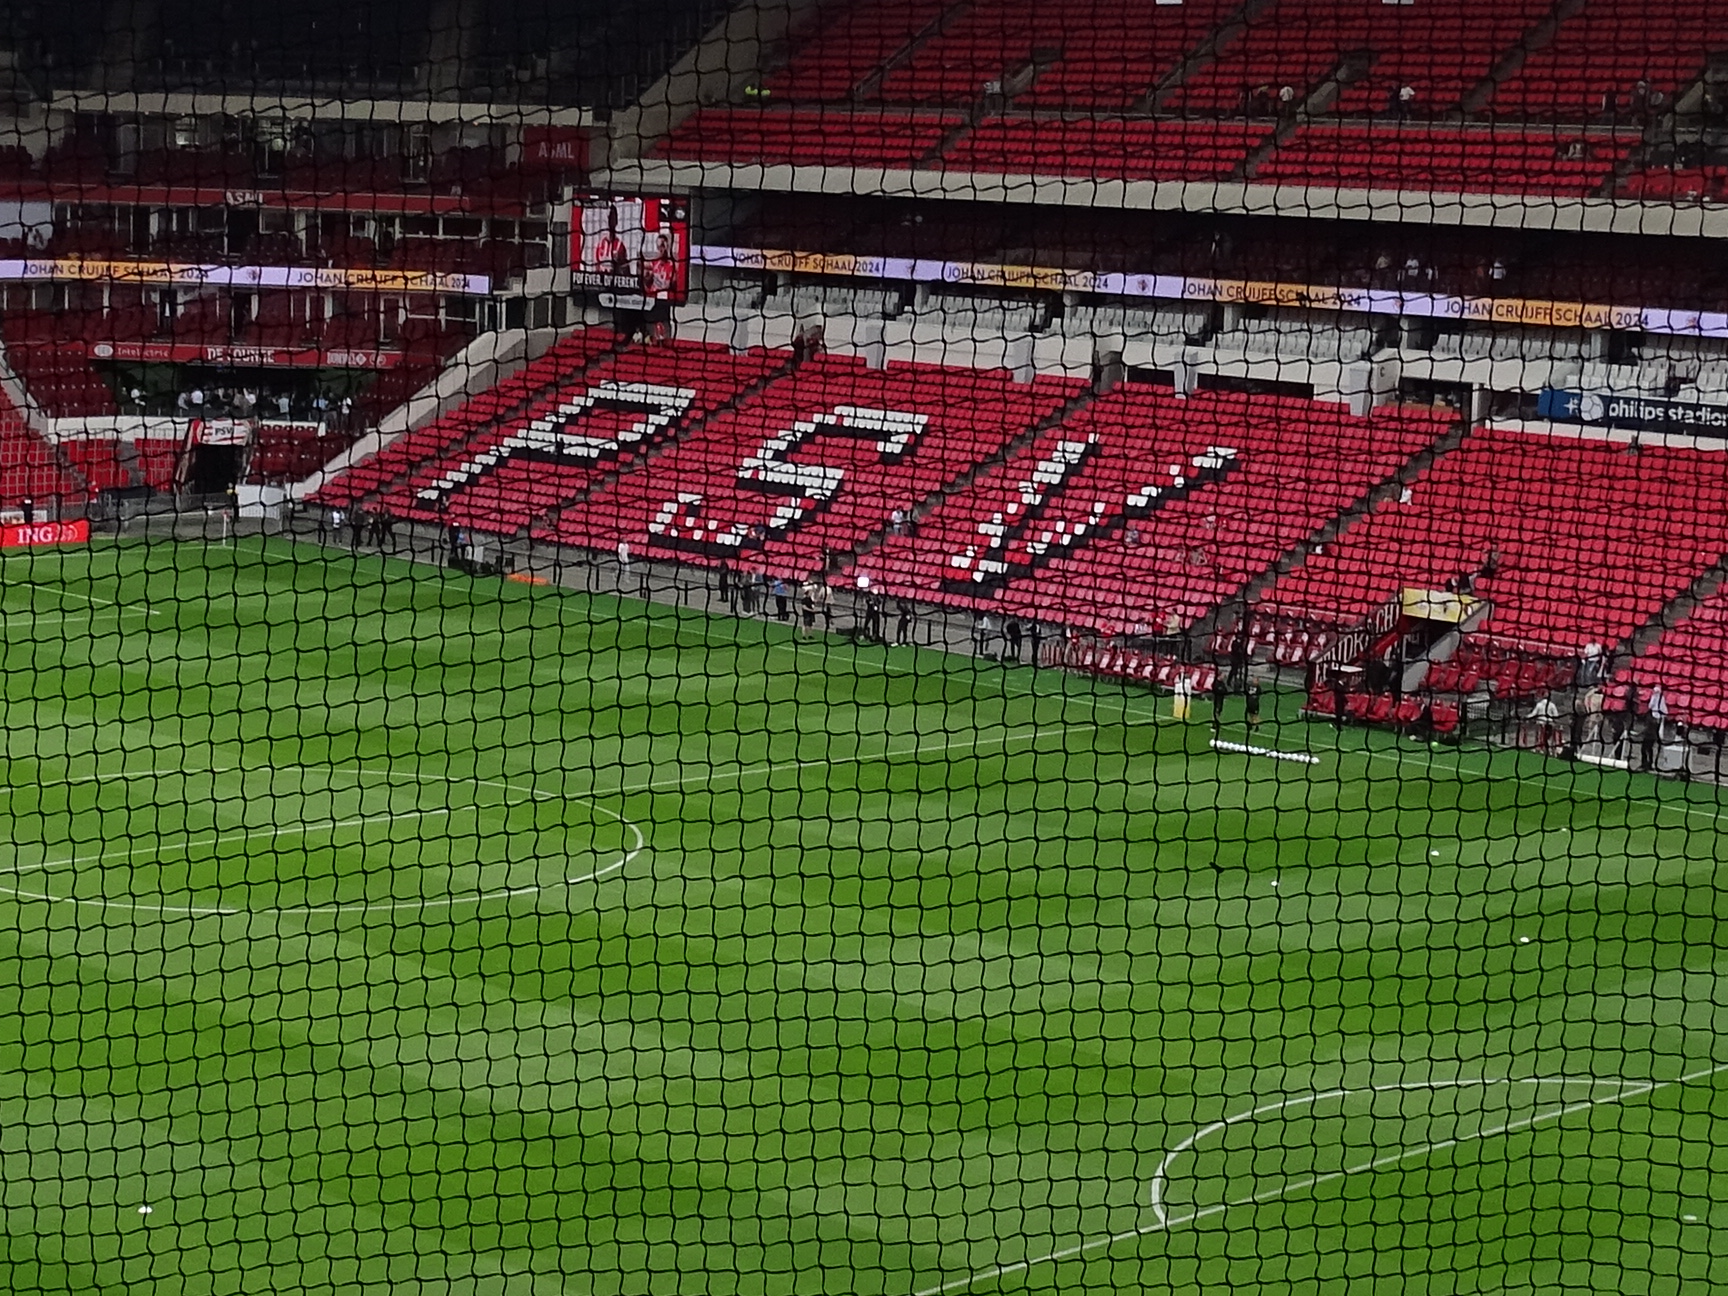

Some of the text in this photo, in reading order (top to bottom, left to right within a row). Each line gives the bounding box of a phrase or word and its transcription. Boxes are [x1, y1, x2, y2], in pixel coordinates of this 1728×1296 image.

[25, 263, 63, 276] JOHAN
[123, 266, 174, 279] SCHAA
[179, 268, 210, 280] 2024
[770, 255, 811, 269] CRUIJFF
[812, 258, 855, 272] SCHAAL
[856, 261, 881, 273] 2024
[297, 272, 343, 284] JOHAN
[946, 265, 986, 279] JOHAN
[1082, 276, 1109, 289] 2024
[1183, 283, 1362, 307] OHAN CRUIJFF SCHAL 2024
[1444, 301, 1649, 326] JOHAN CRUIJFF SCHAAL 2024
[1608, 399, 1664, 421] philips
[18, 525, 54, 544] ING
